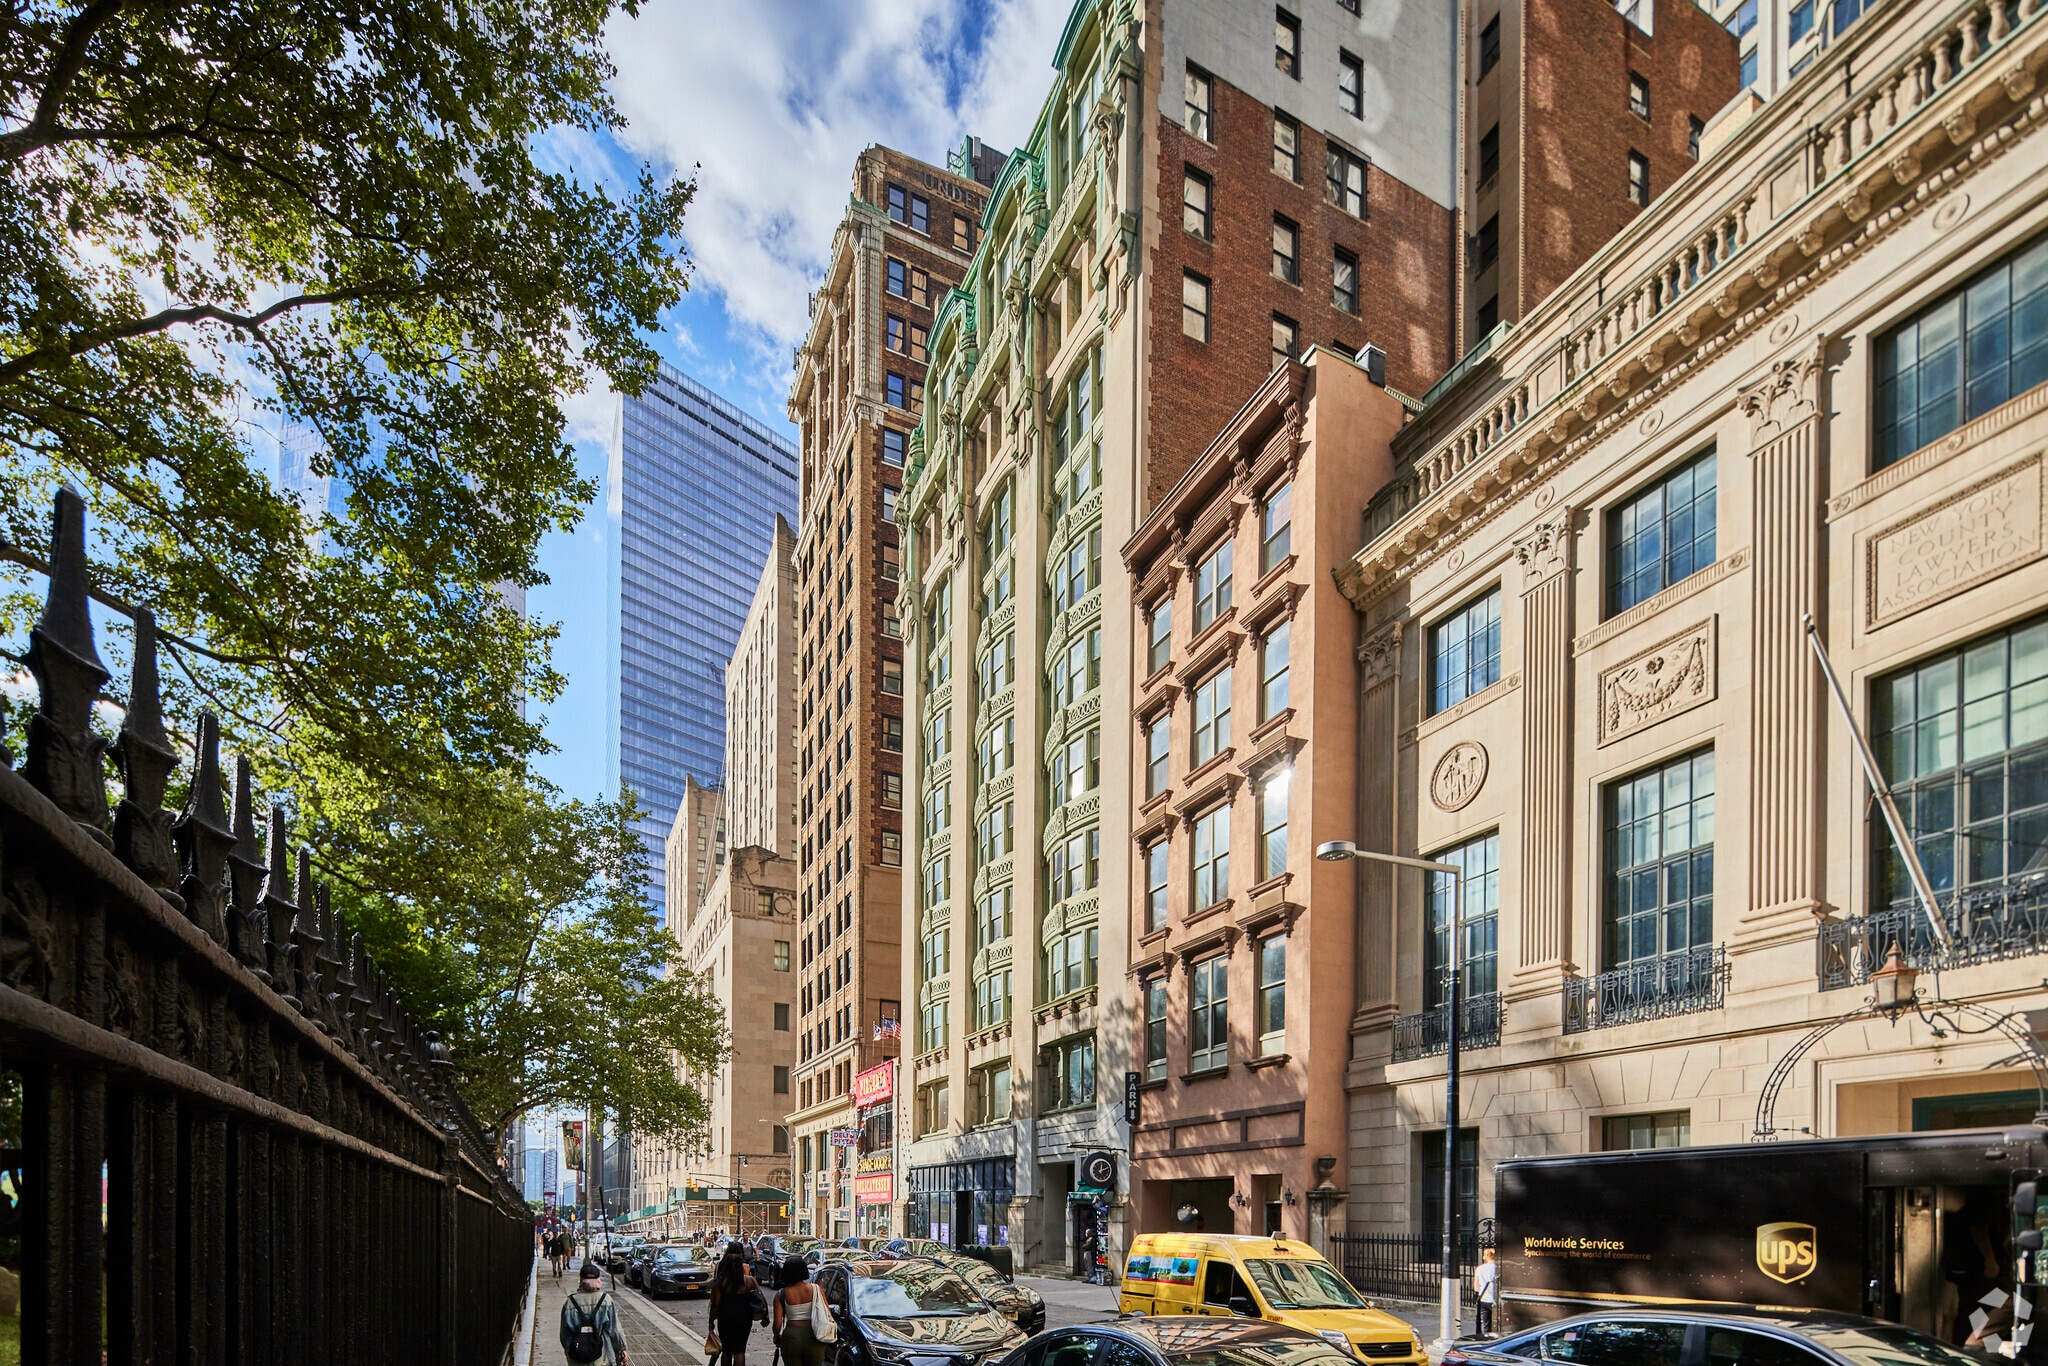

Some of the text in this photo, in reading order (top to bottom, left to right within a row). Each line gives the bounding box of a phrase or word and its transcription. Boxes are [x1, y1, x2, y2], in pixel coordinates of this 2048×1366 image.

[1891, 478, 2021, 554] NEW YORK
[1899, 500, 2013, 566] COUNTY
[1897, 521, 2014, 587] LAWYERS
[1879, 530, 2037, 613] ASSOCIATION
[1128, 1074, 1137, 1108] PARK
[856, 1177, 891, 1194] DELICATESSEN
[1524, 1236, 1625, 1250] Worldwide Services
[1524, 1248, 1568, 1260] Synchronizing
[1570, 1249, 1580, 1258] the
[1582, 1250, 1602, 1259] world
[1612, 1252, 1652, 1261] commerce
[1761, 1240, 1813, 1274] ups
